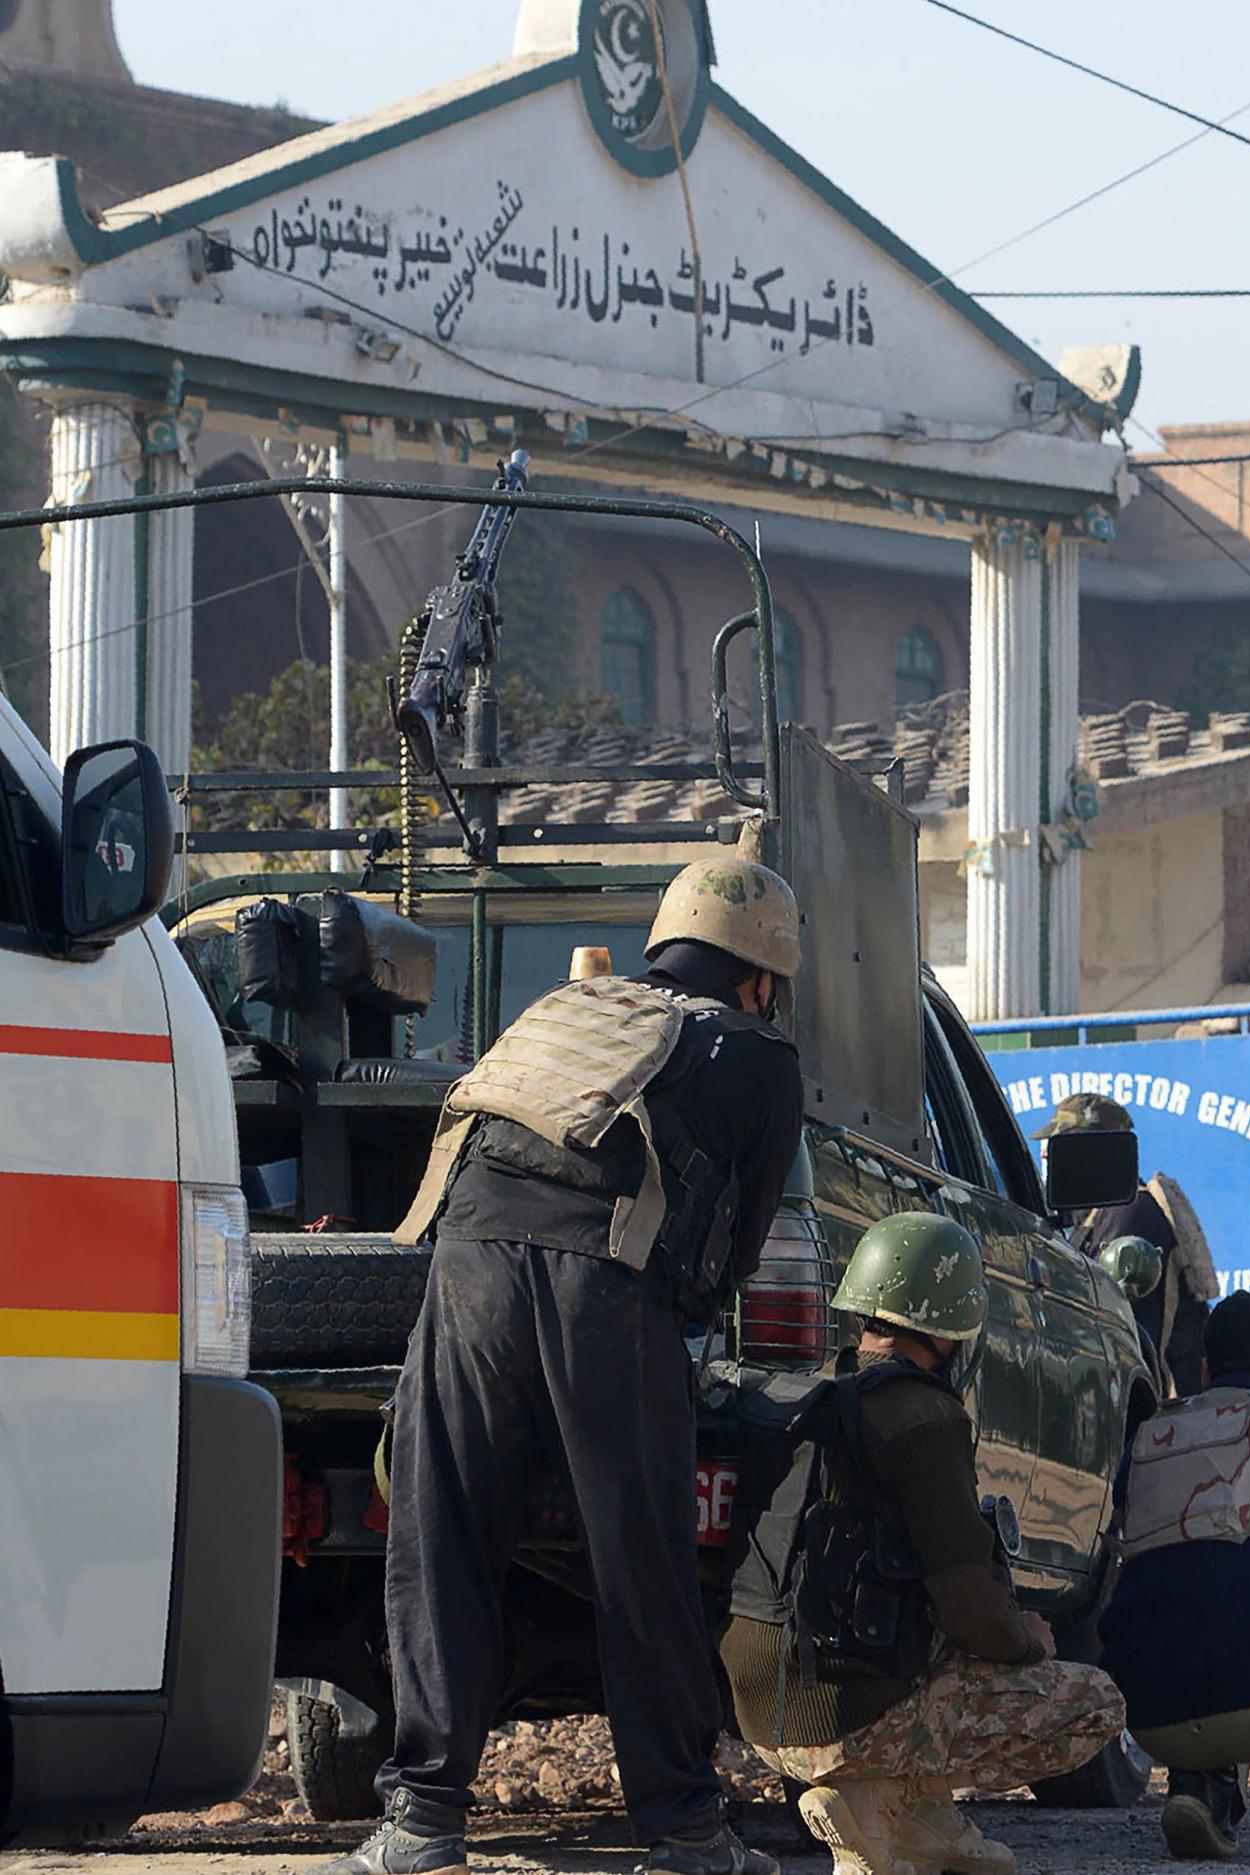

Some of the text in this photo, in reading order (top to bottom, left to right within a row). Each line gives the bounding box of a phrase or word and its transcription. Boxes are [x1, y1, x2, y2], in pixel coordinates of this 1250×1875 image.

[394, 215, 453, 292] خیبر
[494, 225, 581, 311] زراعت
[586, 233, 665, 329] جنرل
[1050, 1071, 1191, 1116] DIRECTOR
